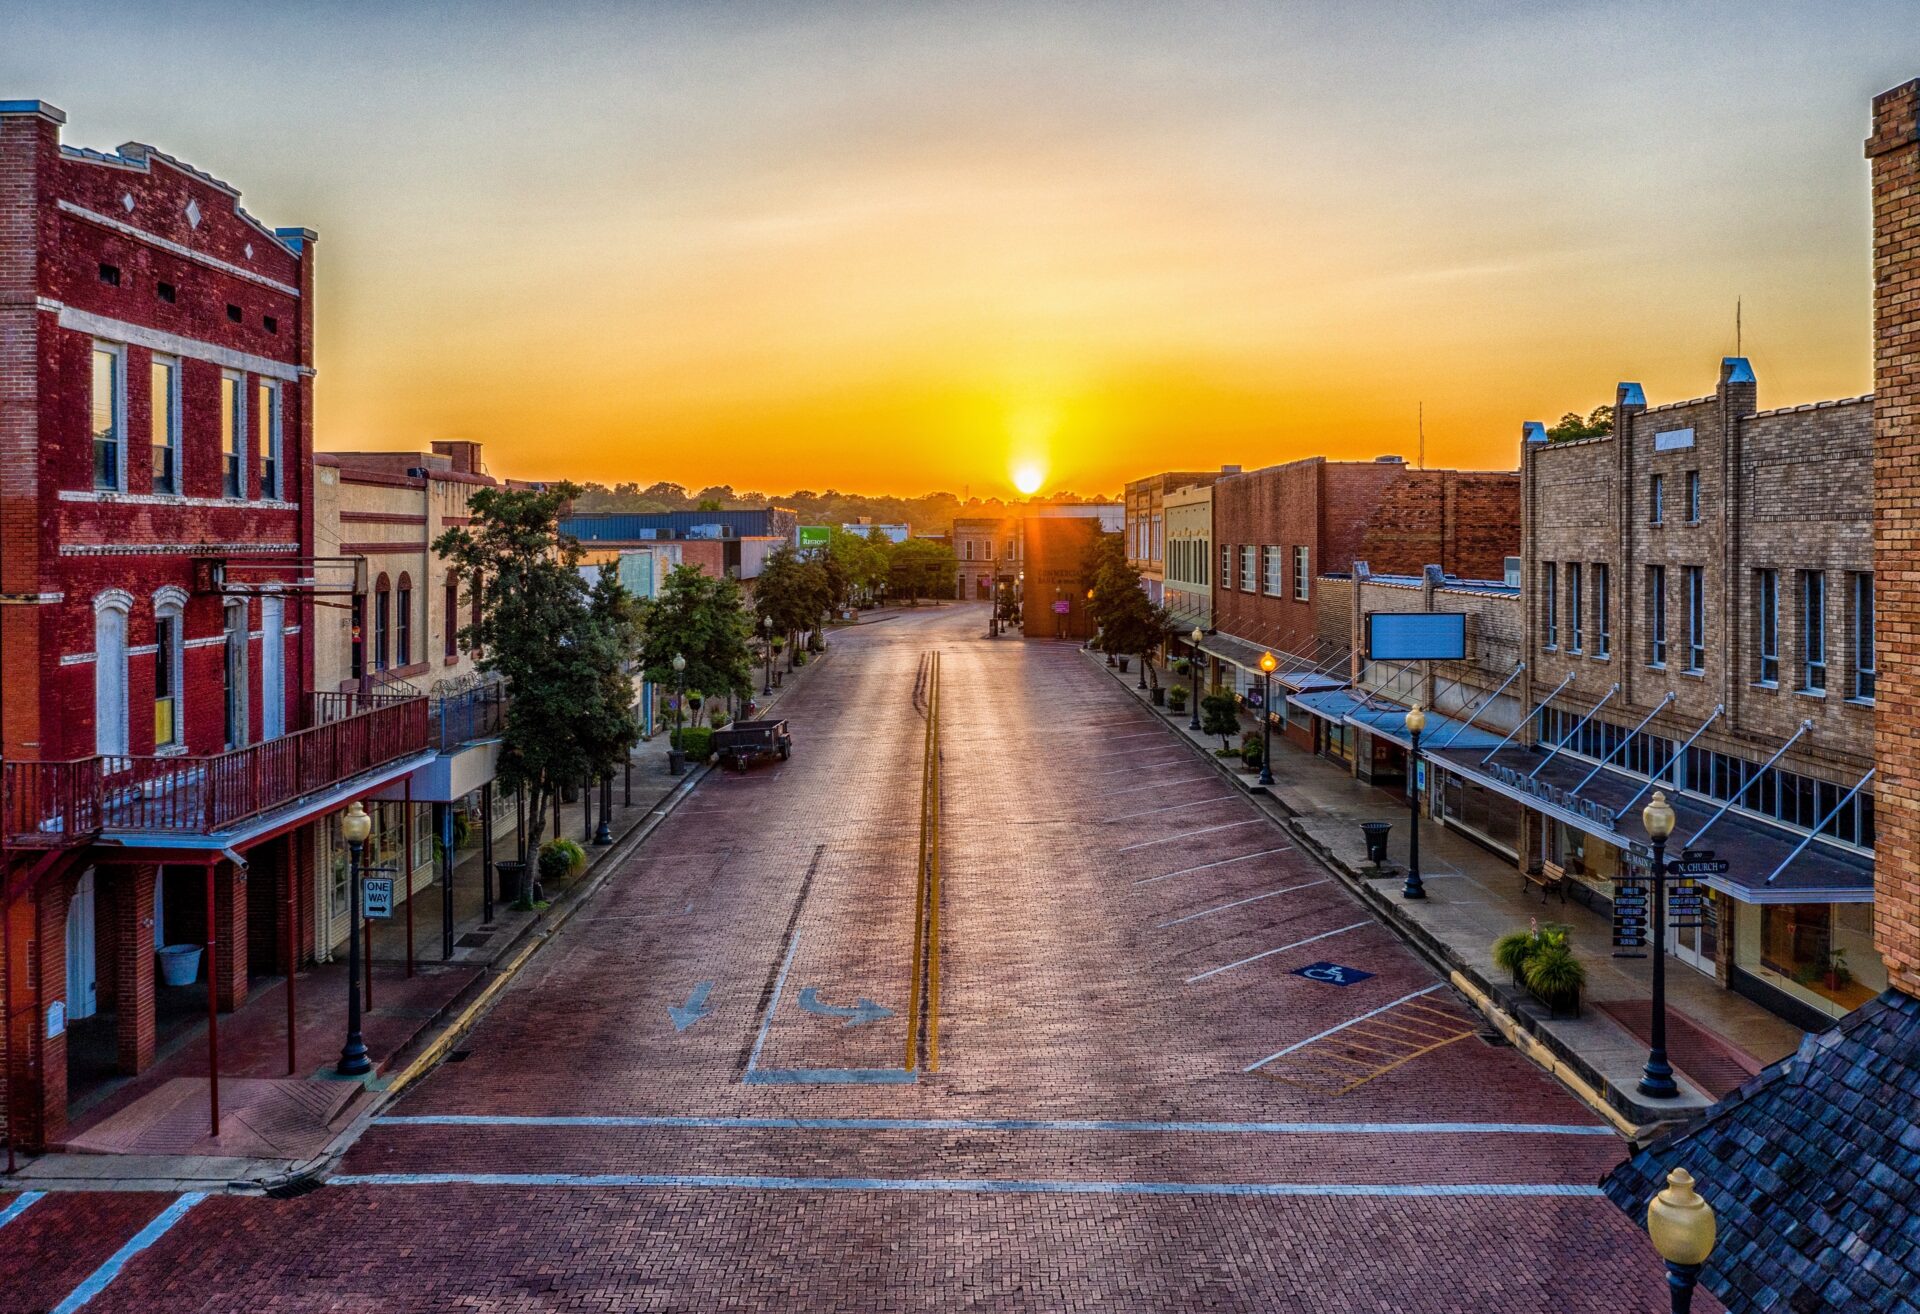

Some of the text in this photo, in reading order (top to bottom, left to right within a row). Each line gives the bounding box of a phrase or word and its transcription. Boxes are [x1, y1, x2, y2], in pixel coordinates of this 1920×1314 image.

[1632, 854, 1649, 868] MAIN
[1678, 863, 1686, 873] N.
[1687, 862, 1718, 873] CHURCH
[367, 881, 389, 891] ONE
[368, 893, 388, 902] WAY
